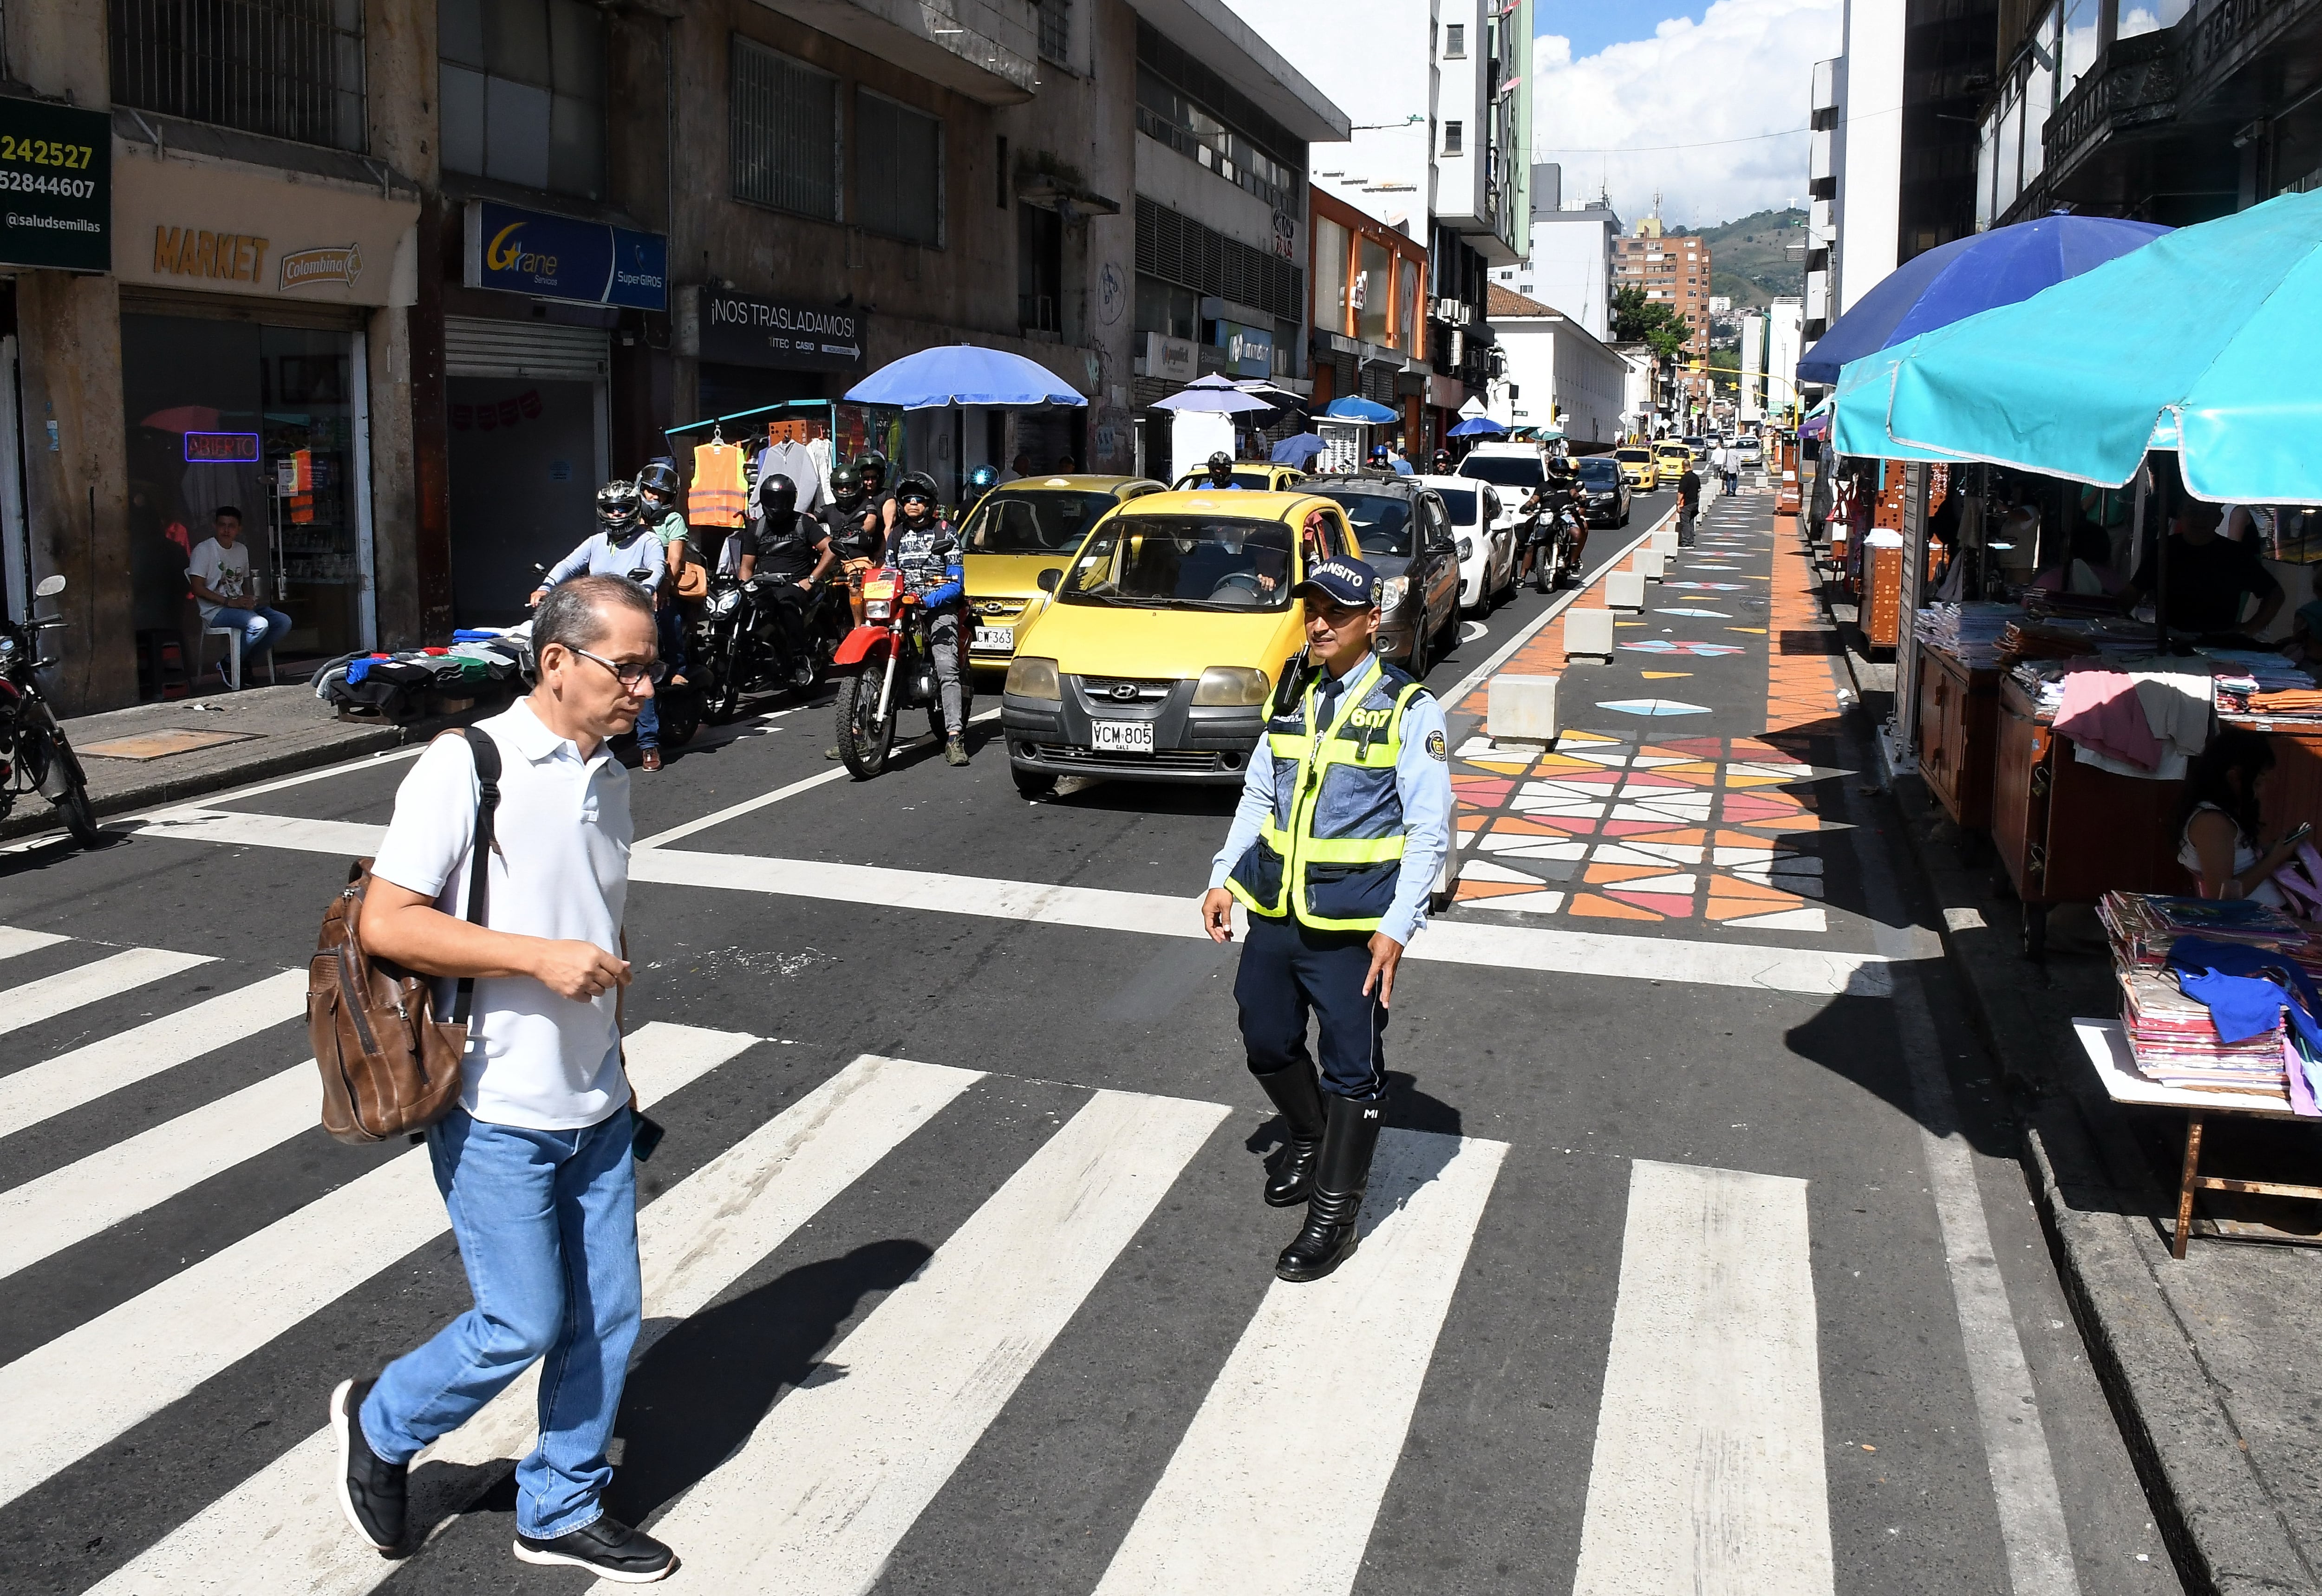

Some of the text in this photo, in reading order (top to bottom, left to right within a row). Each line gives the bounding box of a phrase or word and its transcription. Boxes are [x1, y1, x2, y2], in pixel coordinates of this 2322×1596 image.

[1, 136, 92, 169] 242527
[0, 170, 95, 198] 52844607
[6, 212, 100, 232] @saludsemillas
[153, 225, 342, 283] MARKET Colombina
[534, 274, 557, 286] Servicios
[618, 271, 662, 288] SuperGIROS
[711, 299, 854, 338] ¡NOS TRASLADAMOS!
[795, 340, 815, 351] CASIO
[188, 437, 255, 456] ABIERTO
[1310, 562, 1363, 587] TRANSITO
[1350, 708, 1392, 729] 607
[1363, 1109, 1379, 1119] MI
